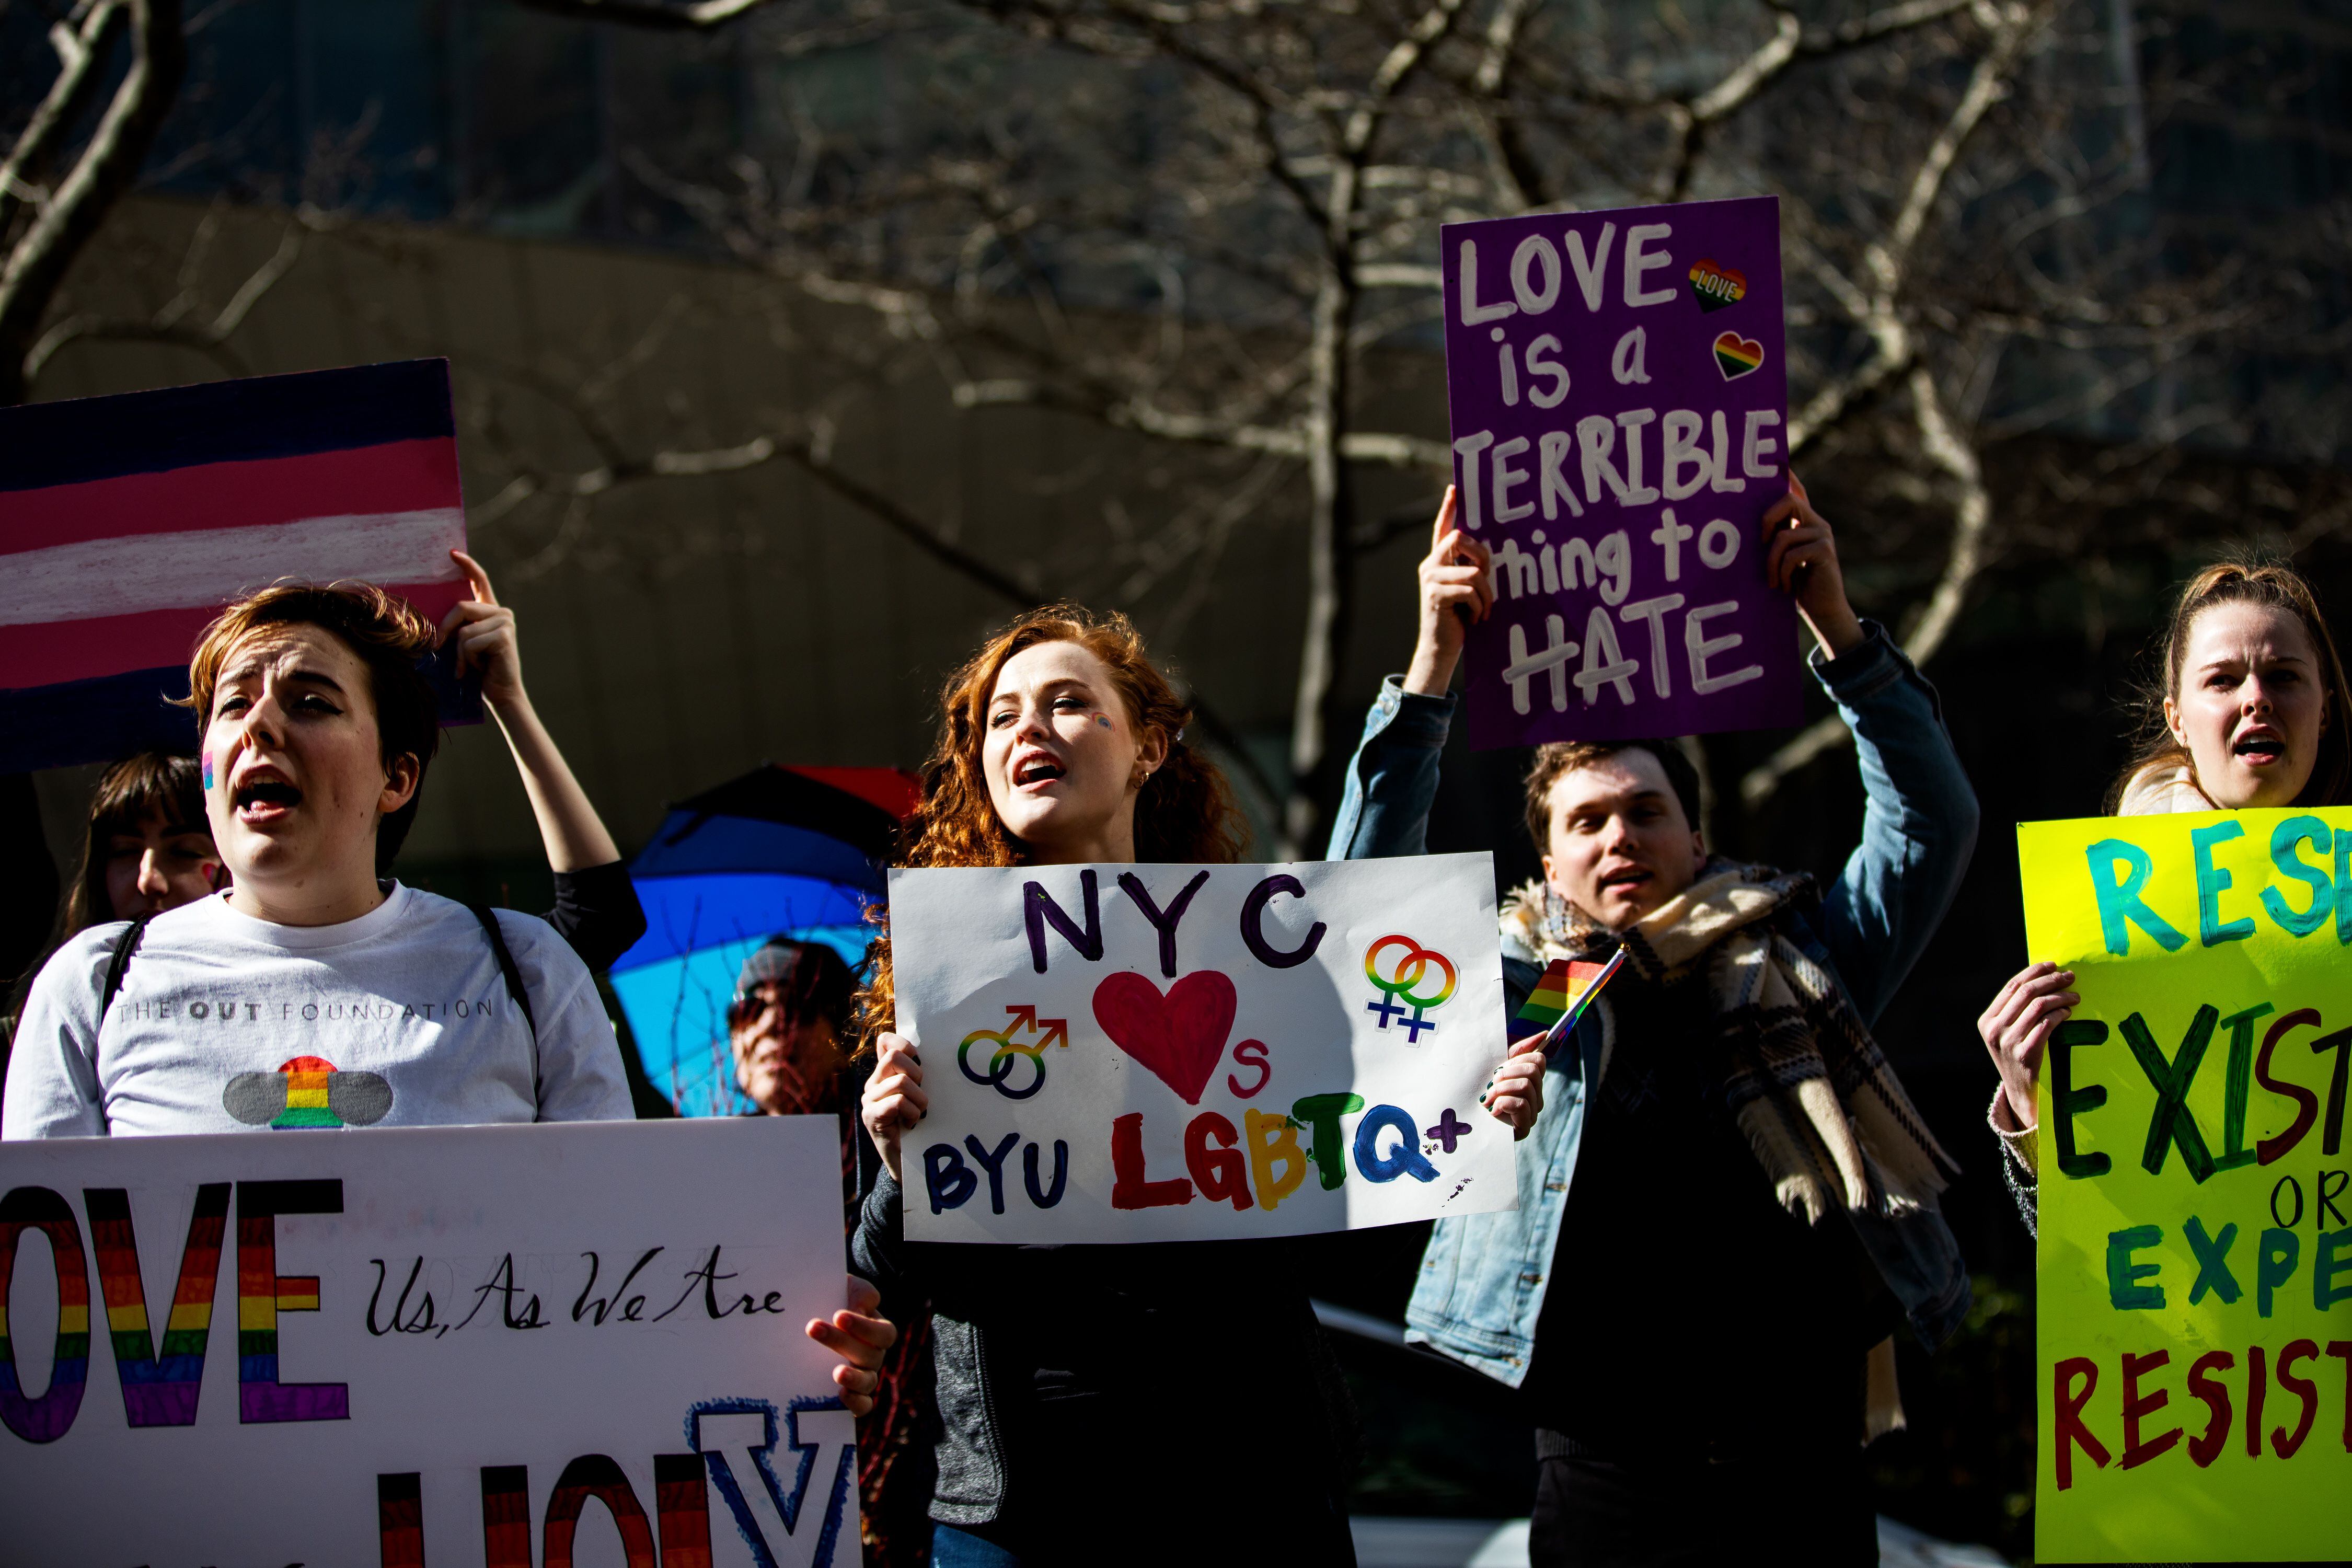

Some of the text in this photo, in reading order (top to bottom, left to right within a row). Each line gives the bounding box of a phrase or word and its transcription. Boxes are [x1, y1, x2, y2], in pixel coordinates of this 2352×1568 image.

[1460, 221, 1677, 327] LOVE
[1696, 269, 1738, 302] LOVE
[1611, 325, 1652, 385] a
[1453, 408, 1781, 530] TERRIBLE
[1651, 507, 1741, 582] to
[1502, 593, 1764, 715] HATE
[1022, 868, 1328, 979] NYC
[117, 998, 493, 1023] THE OUT FOUNDATION
[2048, 1001, 2352, 1185] EXIST
[924, 1092, 1473, 1216] BYU LGBTQ+
[2270, 1170, 2350, 1231] OR
[366, 1255, 451, 1339] Us,
[454, 1251, 551, 1330] As
[572, 1246, 665, 1326] We
[652, 1243, 786, 1322] Are
